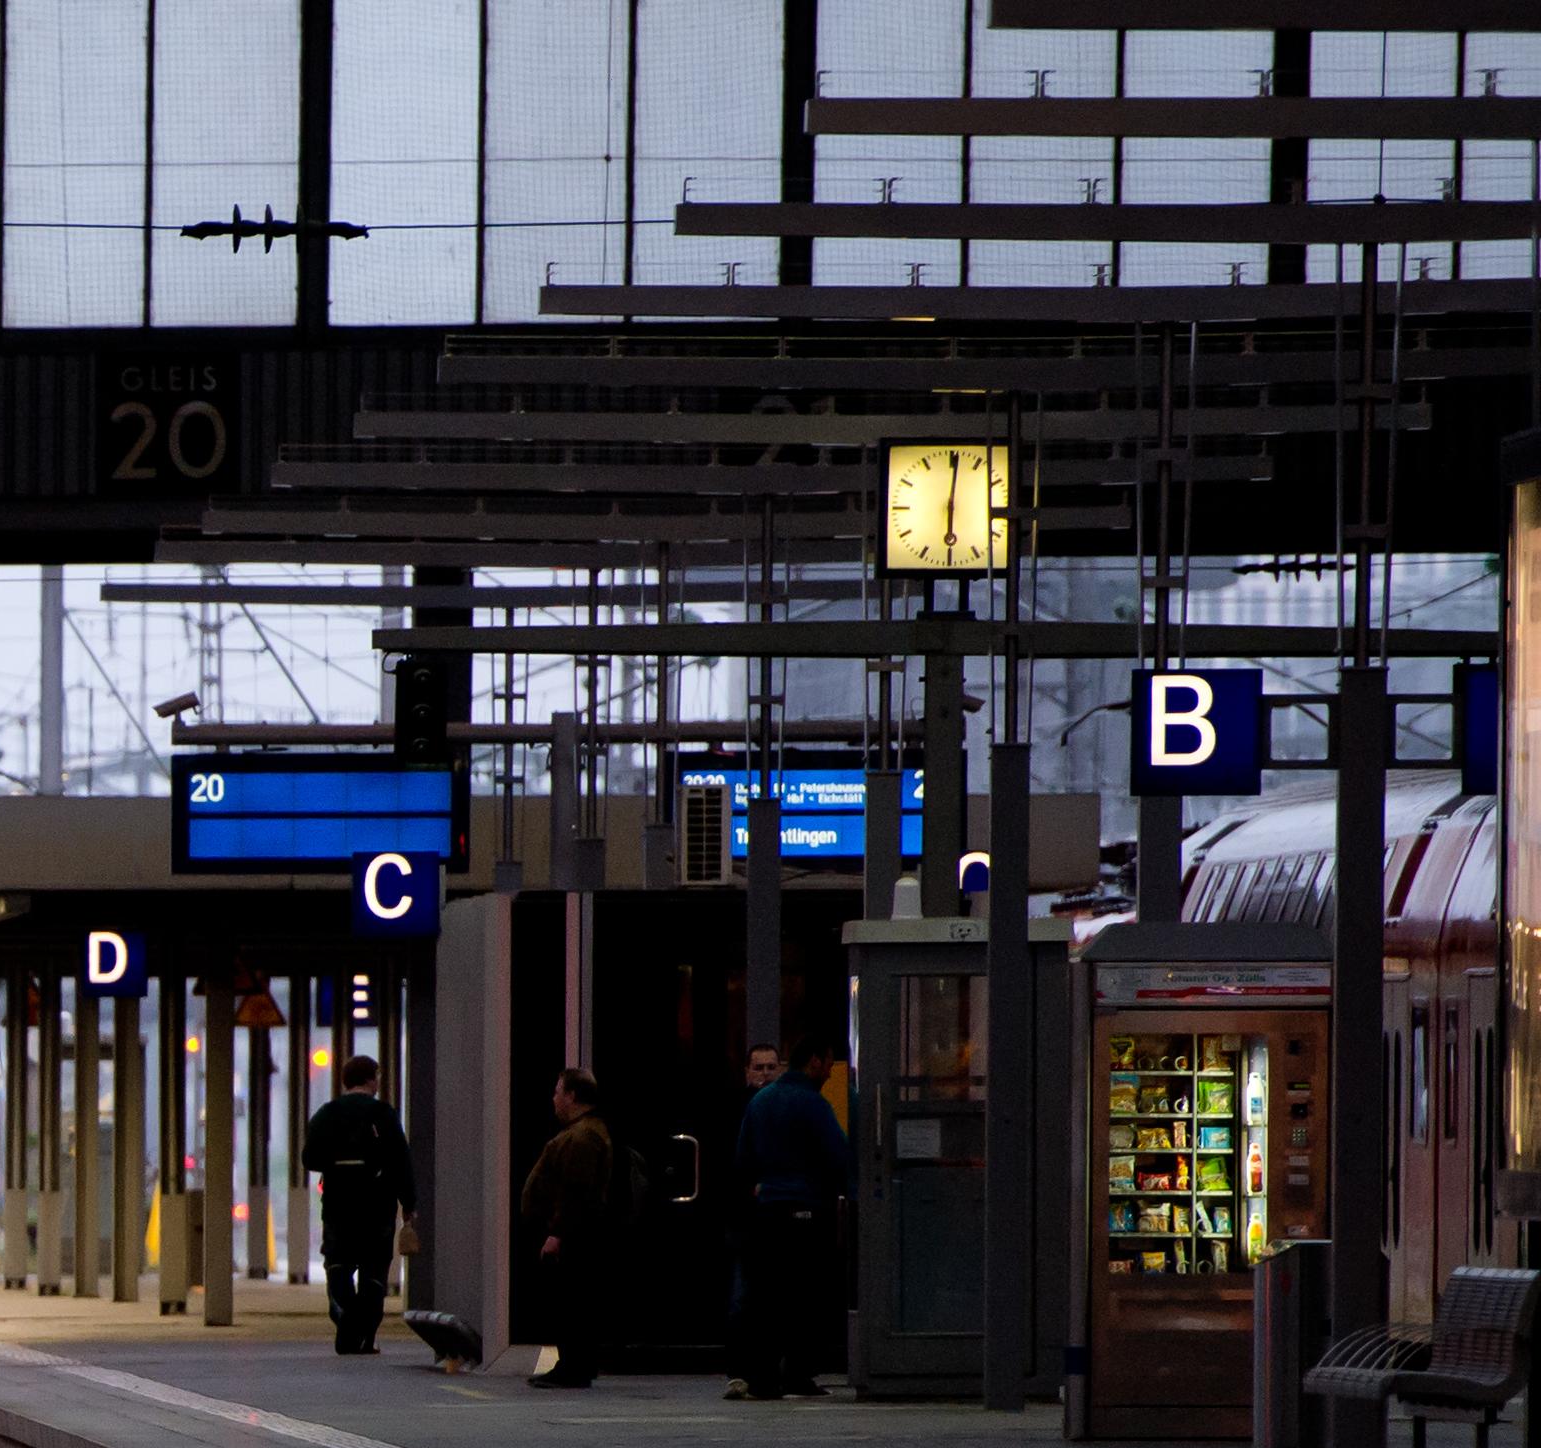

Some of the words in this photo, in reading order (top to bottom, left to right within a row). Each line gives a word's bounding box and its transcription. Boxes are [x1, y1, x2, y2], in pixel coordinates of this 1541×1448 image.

[120, 364, 219, 393] GLEIS
[109, 400, 228, 481] 20
[1150, 675, 1216, 766] B
[190, 773, 224, 803] 20
[364, 853, 413, 919] C
[88, 931, 128, 984] D
